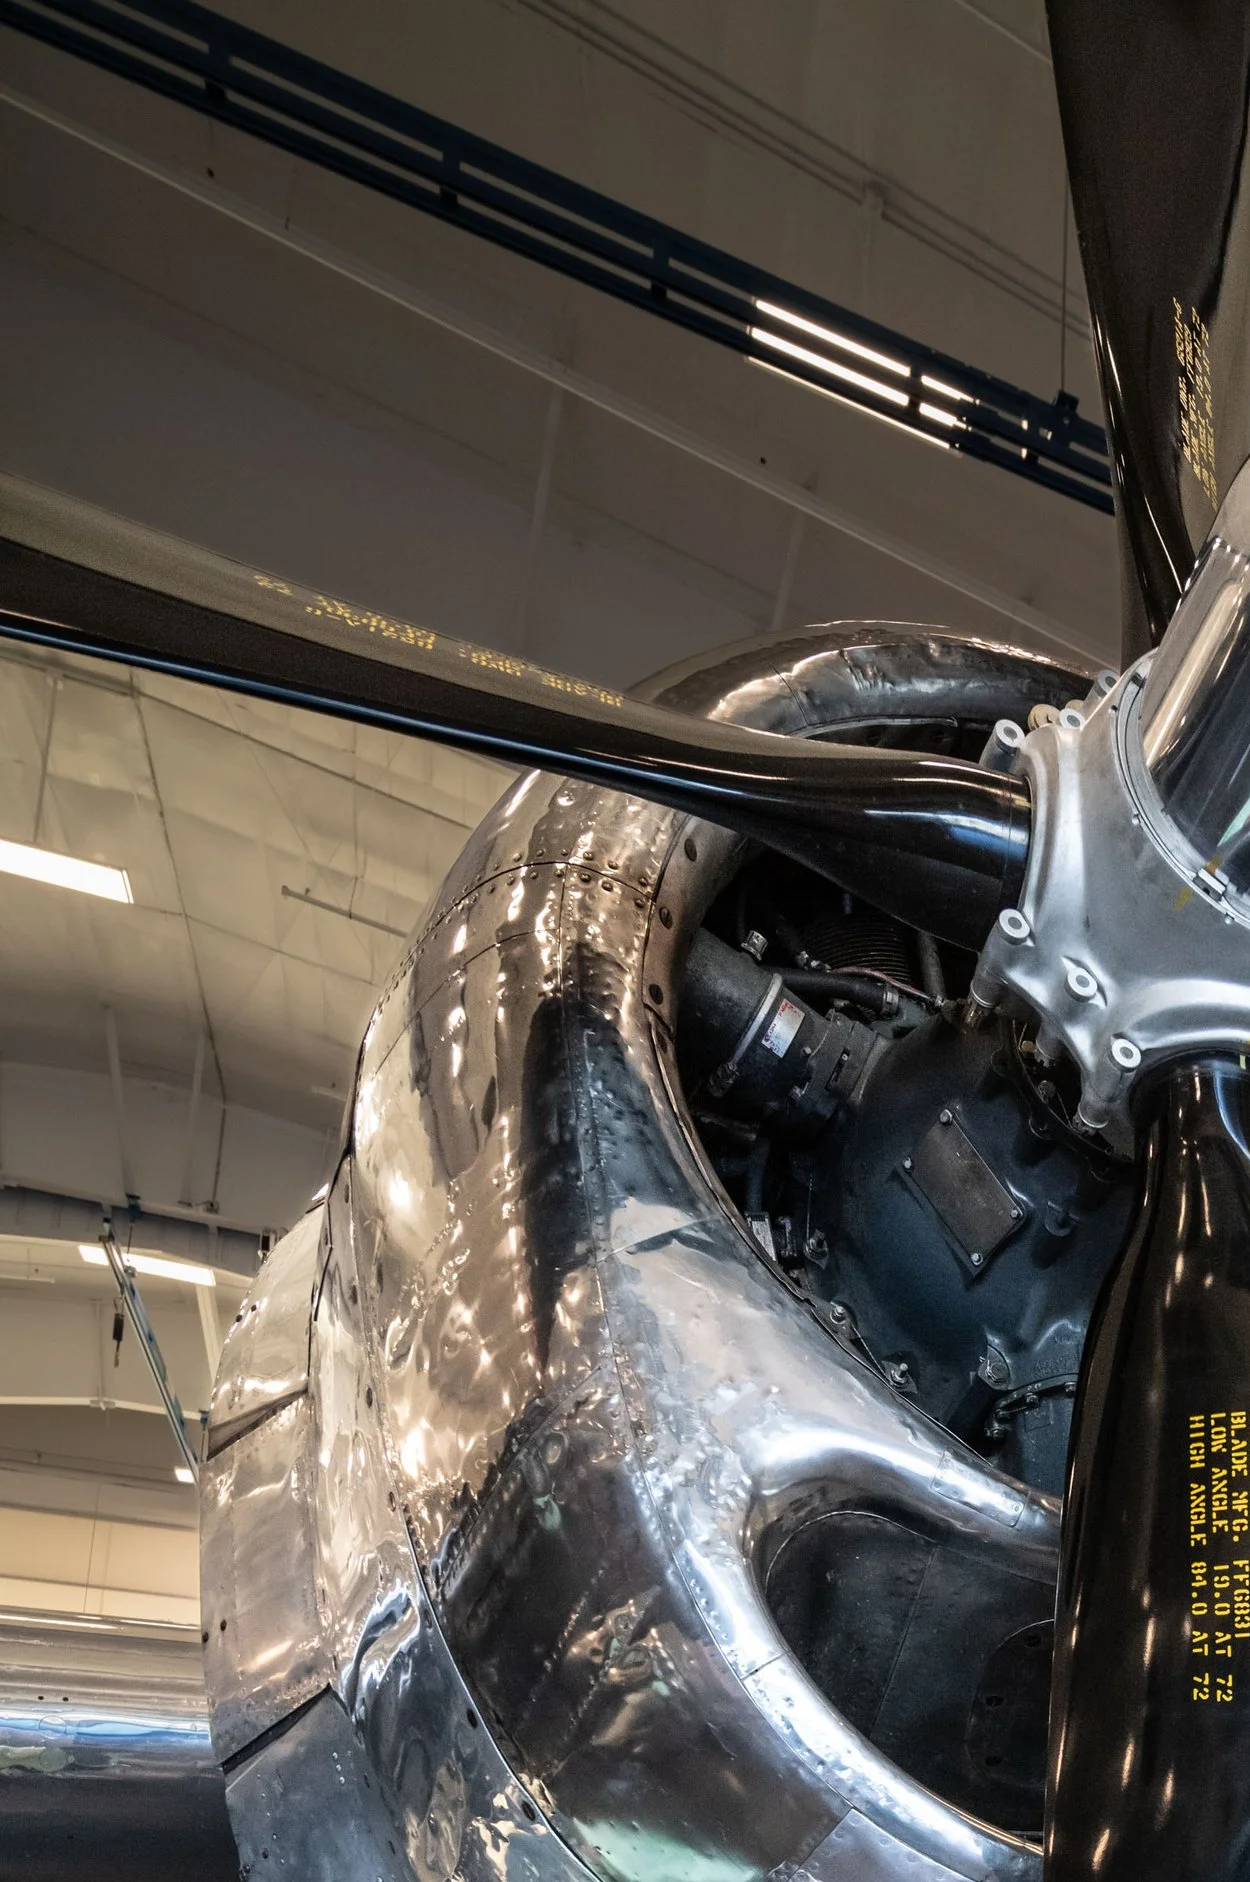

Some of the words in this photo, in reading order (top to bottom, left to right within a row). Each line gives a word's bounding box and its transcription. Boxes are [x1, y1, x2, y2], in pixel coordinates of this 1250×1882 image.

[1189, 1416, 1205, 1468] HIGH
[1210, 1413, 1227, 1452] LOW
[1231, 1411, 1249, 1477] BLADE
[1190, 1483, 1206, 1547] ANGLE
[1211, 1468, 1228, 1533] ANGLE
[1232, 1491, 1250, 1542] MFG.
[1191, 1561, 1207, 1616] 84.0
[1213, 1565, 1231, 1616] 19.0
[1233, 1560, 1250, 1638] FF6831
[1192, 1630, 1209, 1656] AT
[1214, 1631, 1233, 1657] AT
[1192, 1673, 1209, 1701] 72
[1216, 1674, 1233, 1702] 72
